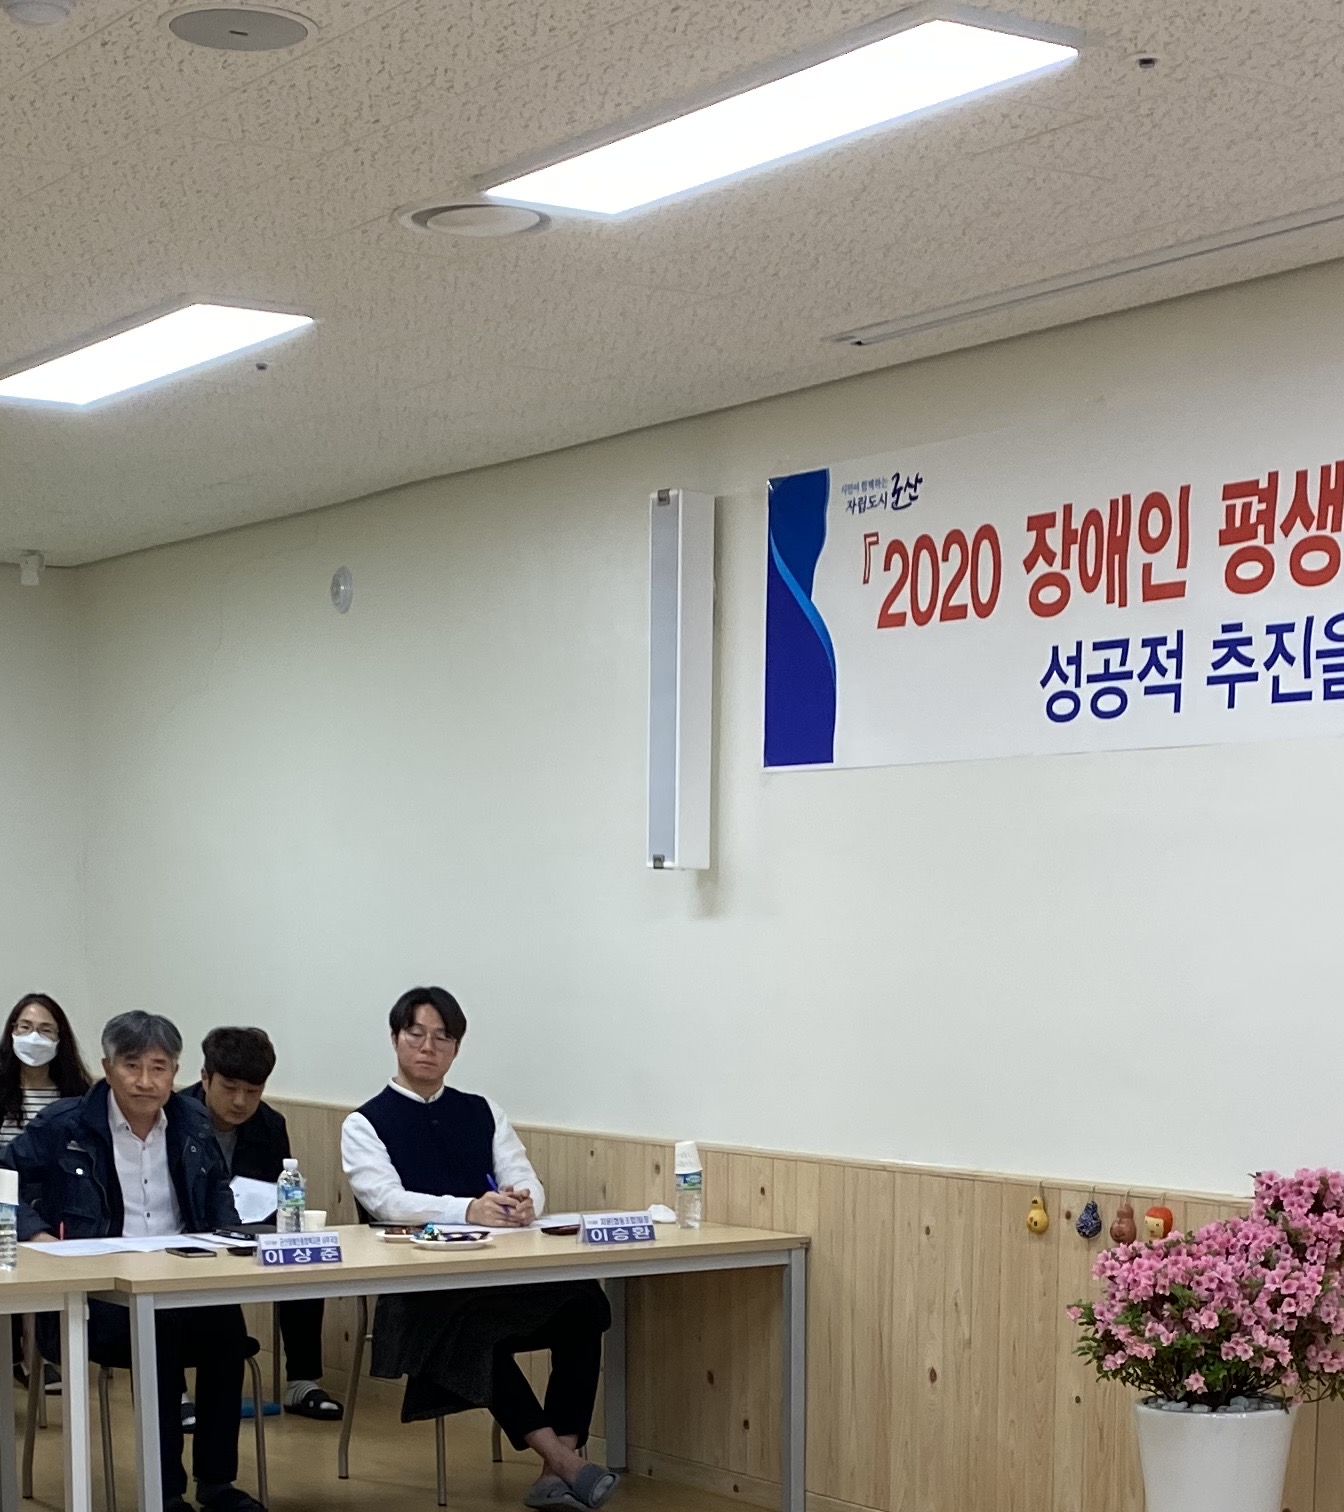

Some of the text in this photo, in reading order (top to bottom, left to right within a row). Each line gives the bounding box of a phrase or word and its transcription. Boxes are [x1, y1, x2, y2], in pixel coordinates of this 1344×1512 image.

[846, 491, 888, 516] 자립도시
[1023, 485, 1191, 618] 장애인
[1040, 629, 1184, 723] 성공적
[264, 1247, 340, 1264] 이상준
